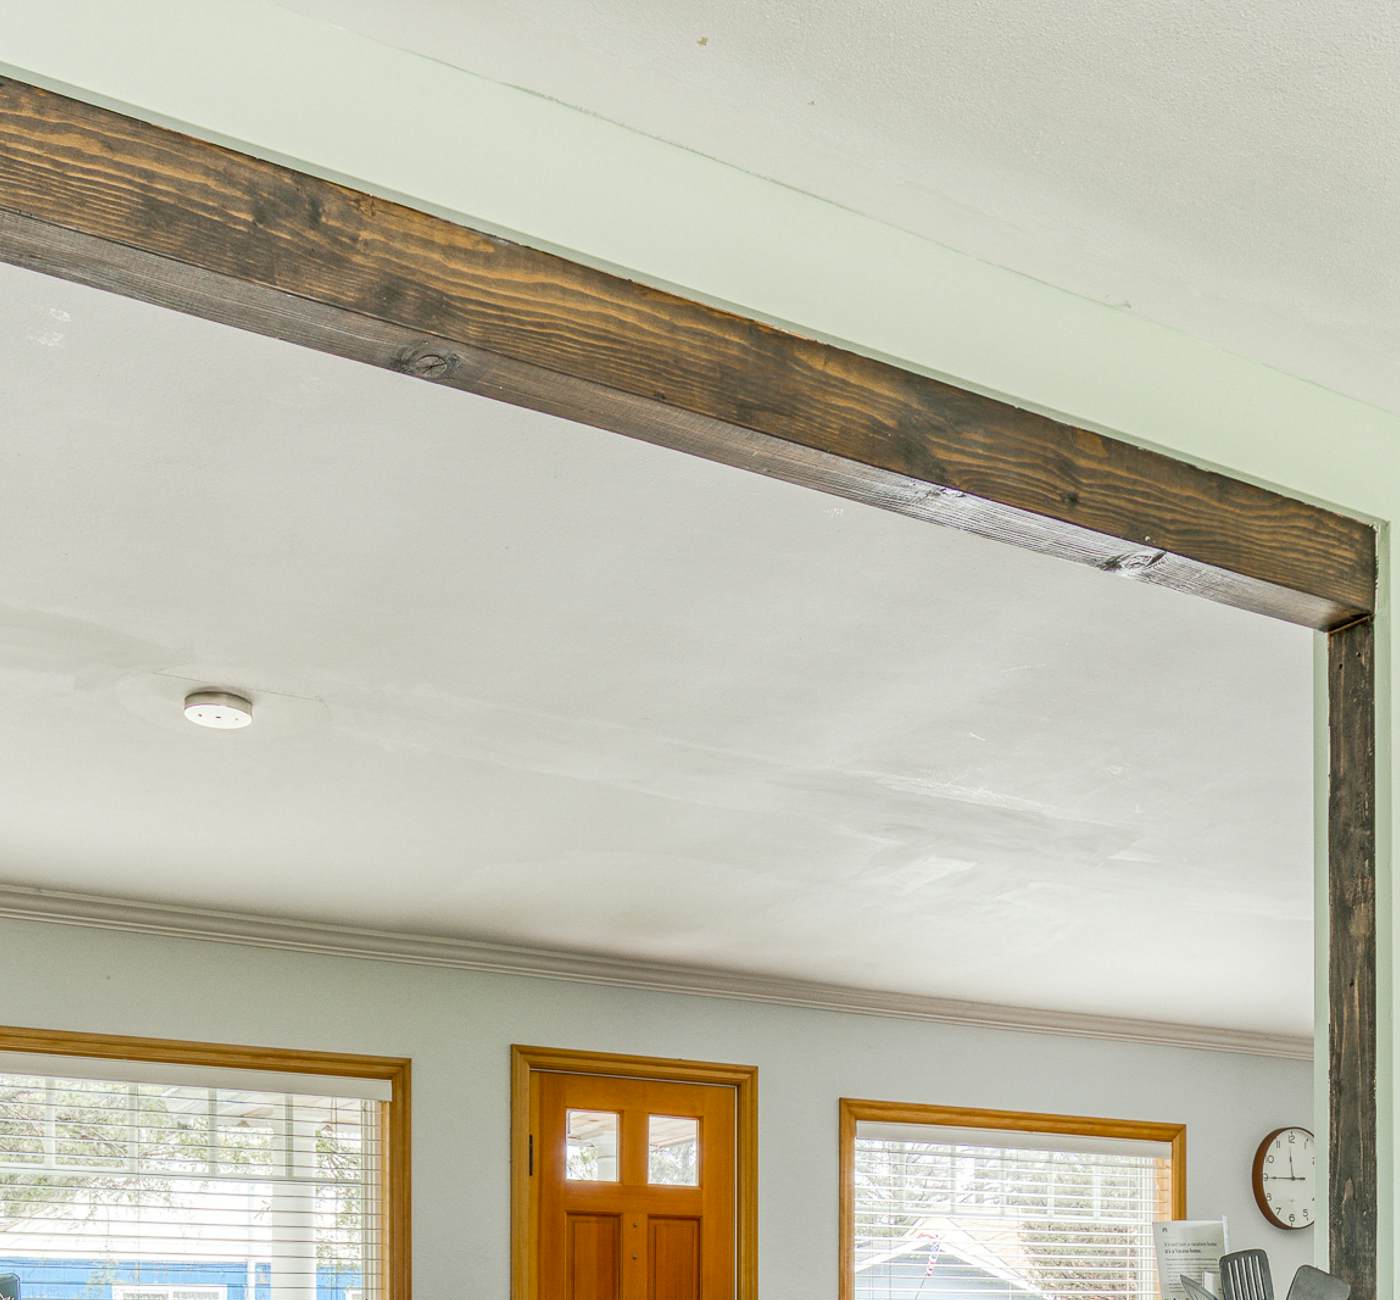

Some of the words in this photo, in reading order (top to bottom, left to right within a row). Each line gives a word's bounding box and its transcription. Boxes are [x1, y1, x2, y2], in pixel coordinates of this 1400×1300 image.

[1288, 1135, 1295, 1144] 12
[1275, 1207, 1282, 1216] 7
[1302, 1208, 1309, 1218] 5
[1288, 1213, 1296, 1223] 6
